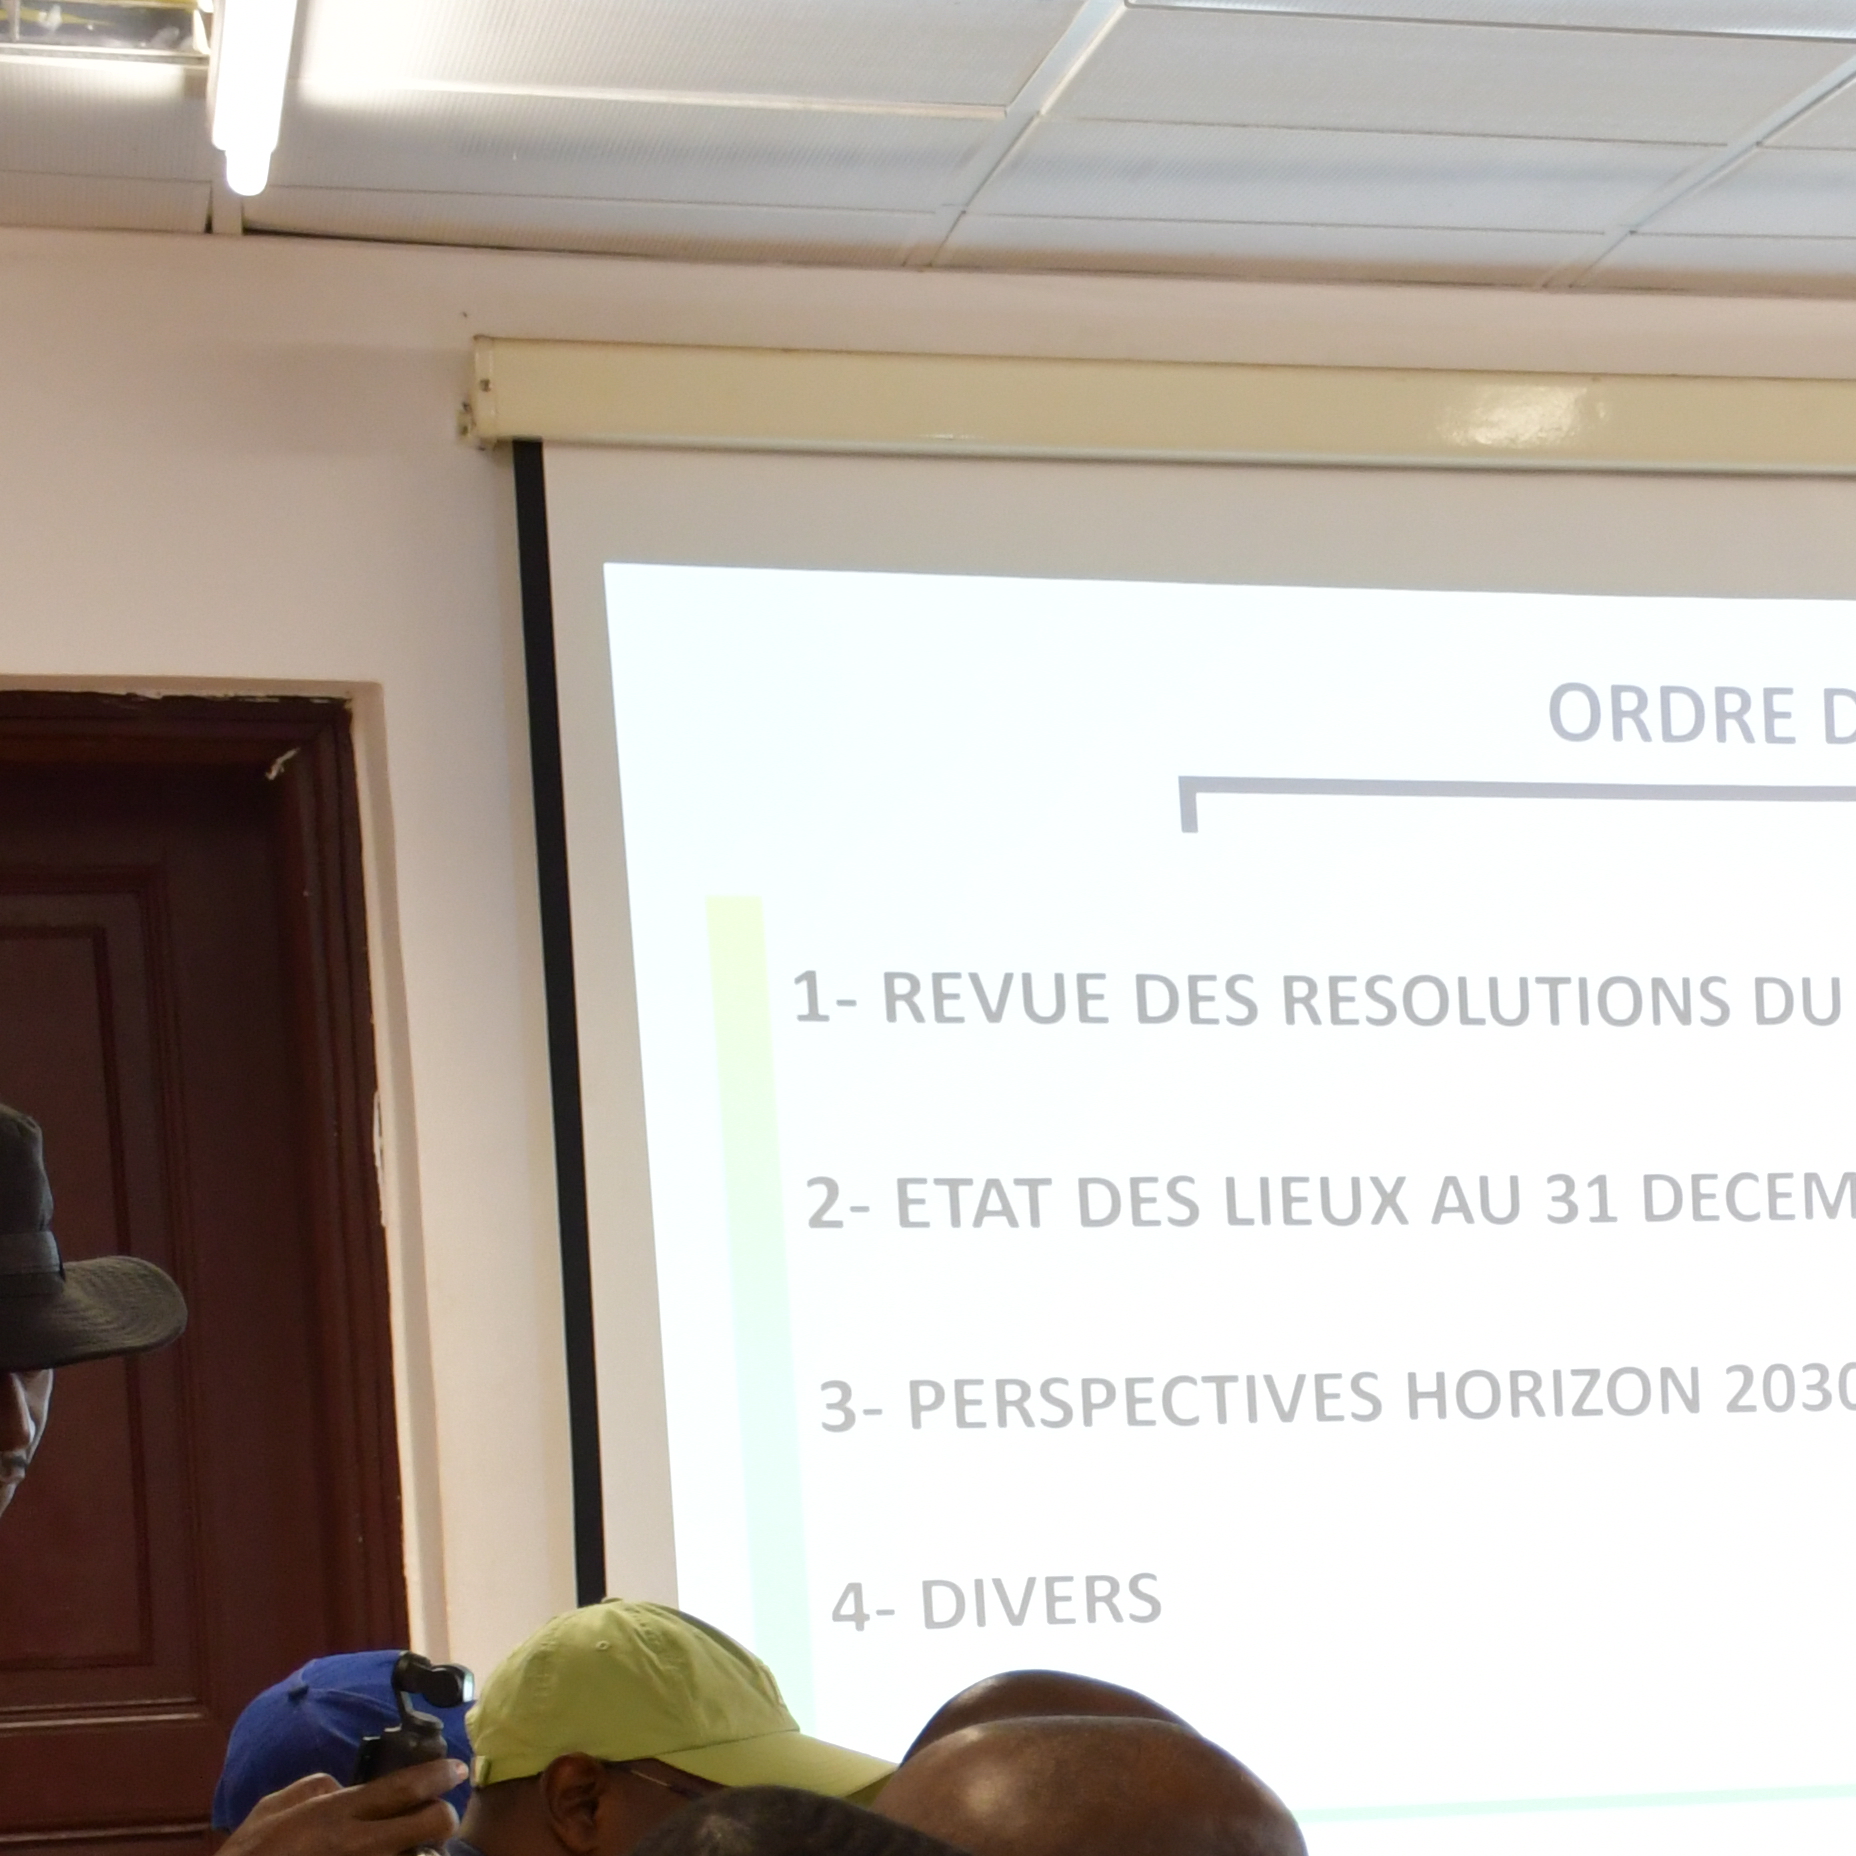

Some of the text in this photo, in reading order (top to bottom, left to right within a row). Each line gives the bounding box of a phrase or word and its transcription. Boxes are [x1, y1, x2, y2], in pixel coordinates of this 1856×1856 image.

[1548, 681, 1798, 746] ORDRE
[793, 968, 859, 1024] 1-
[882, 970, 1111, 1026] REVUE
[1134, 972, 1260, 1028] DES
[1282, 973, 1732, 1029] RESOLUTIONS
[1753, 975, 1843, 1028] DU
[805, 1175, 871, 1230] 2-
[895, 1176, 1054, 1230] ETAT
[1076, 1174, 1201, 1229] DES
[1224, 1174, 1411, 1228] LIEUX
[1429, 1173, 1521, 1227] AU
[1545, 1172, 1619, 1226] 31
[819, 1378, 884, 1434] 3-
[908, 1370, 1384, 1431] PERSPECTIVES
[1406, 1365, 1701, 1422] HORIZON
[830, 1571, 1163, 1633] 4- DIVERS
